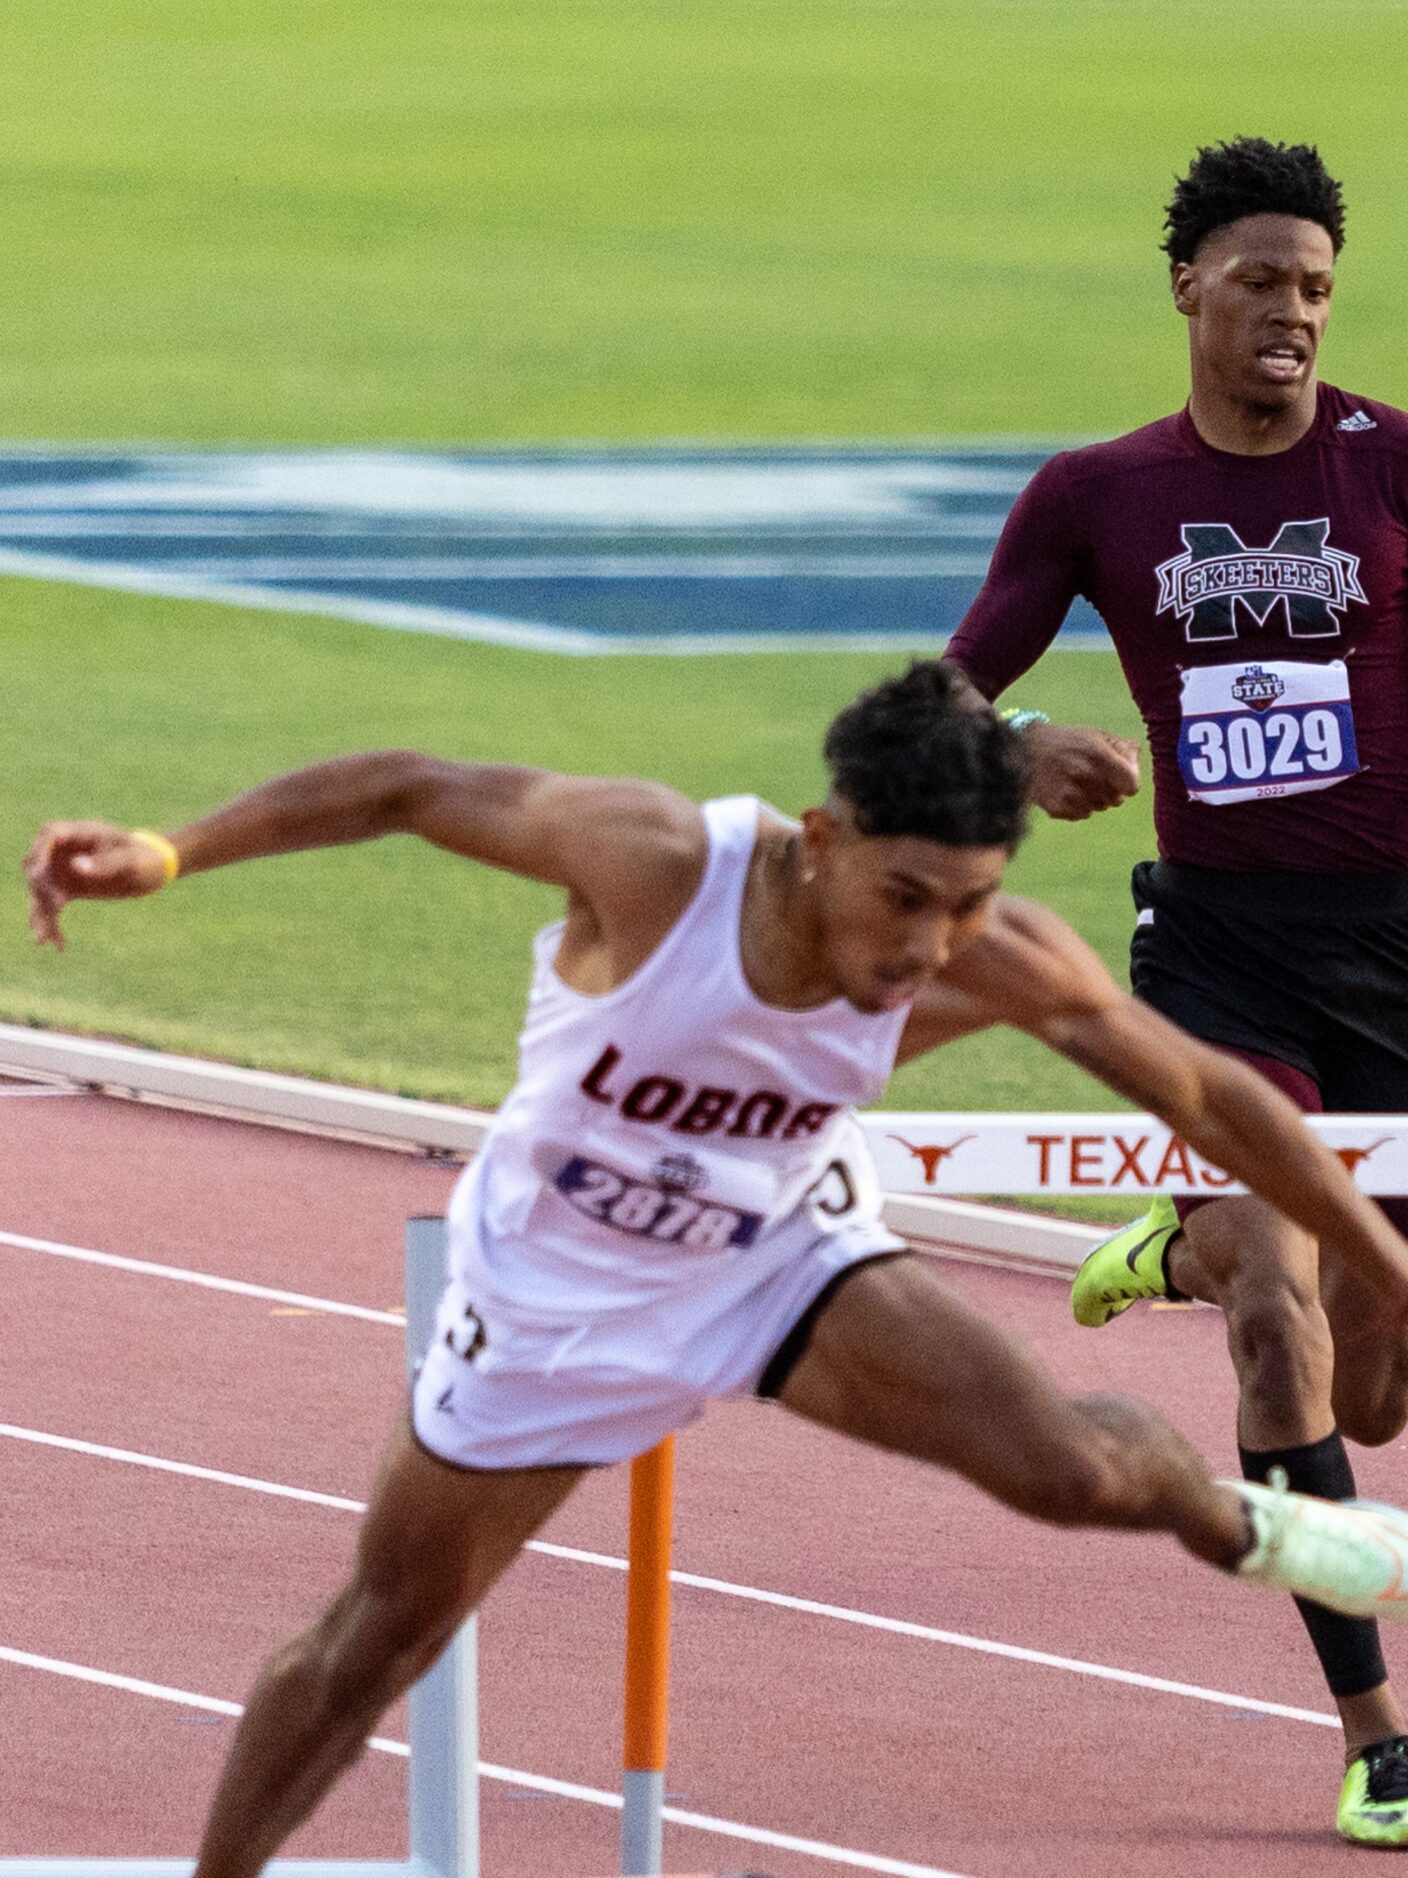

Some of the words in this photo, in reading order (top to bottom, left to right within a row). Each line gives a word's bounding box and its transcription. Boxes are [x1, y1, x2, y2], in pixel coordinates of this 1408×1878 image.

[1185, 559, 1332, 600] SKEETERS
[1232, 681, 1284, 698] STATE
[1188, 709, 1343, 784] 3029
[1257, 785, 1286, 797] 2022
[569, 1168, 741, 1248] 2878
